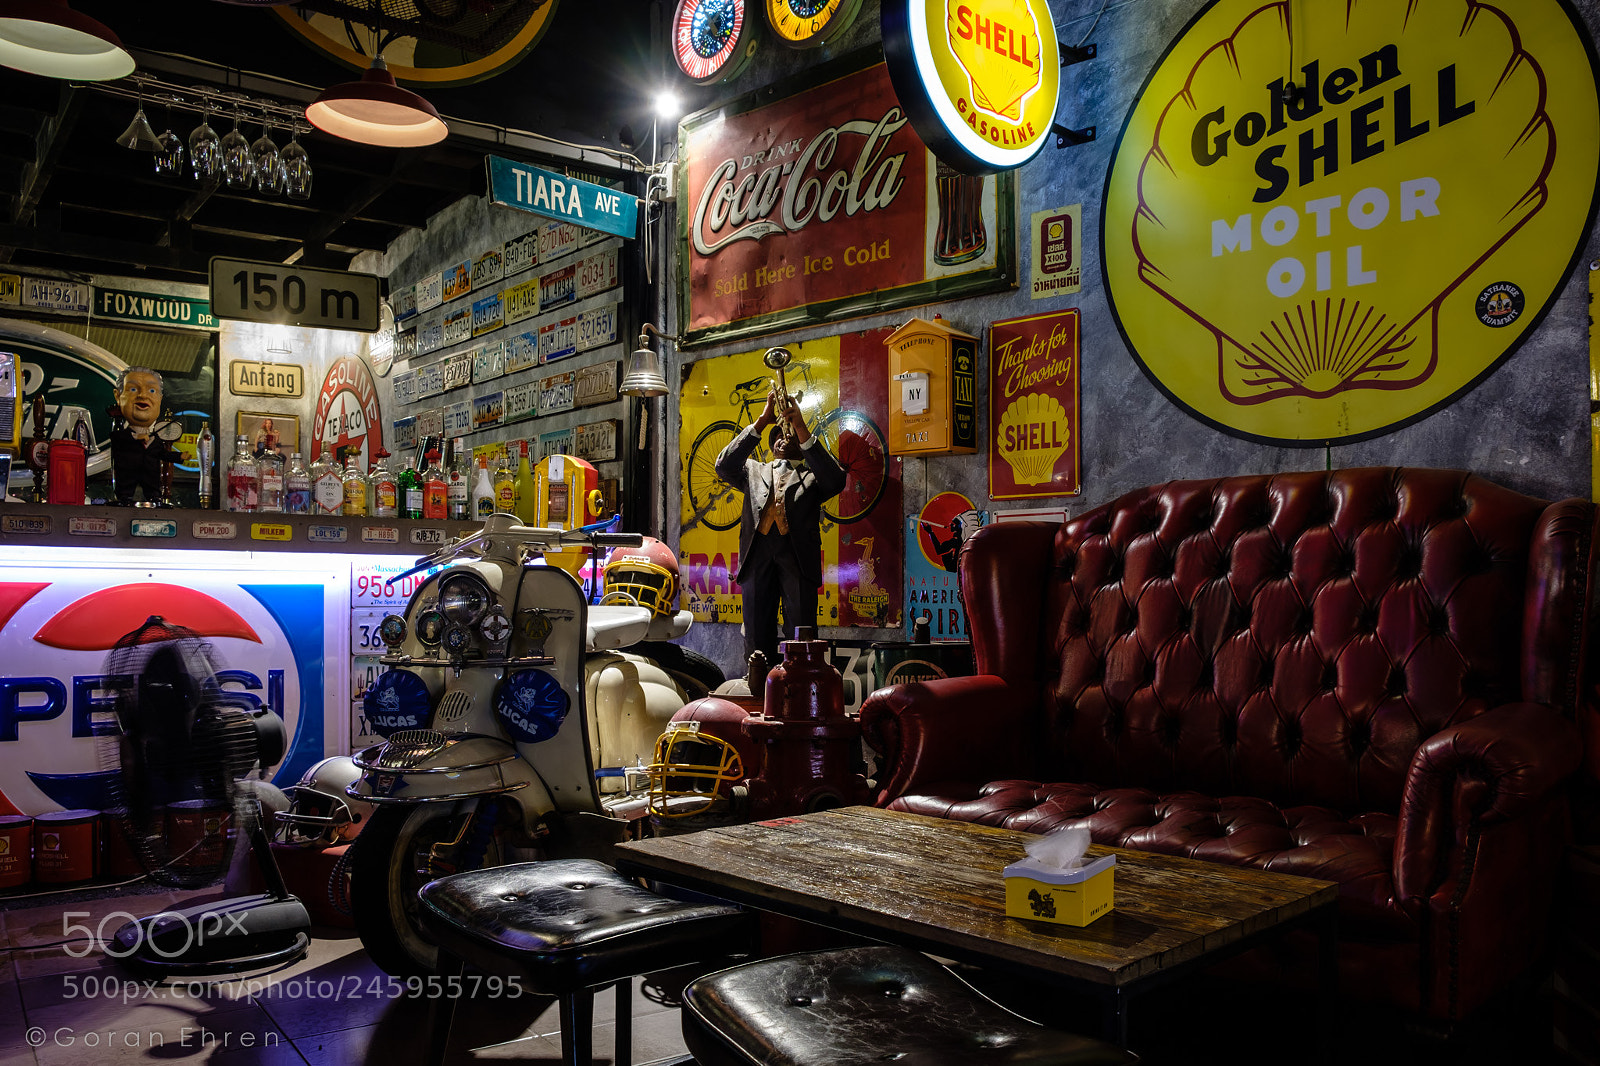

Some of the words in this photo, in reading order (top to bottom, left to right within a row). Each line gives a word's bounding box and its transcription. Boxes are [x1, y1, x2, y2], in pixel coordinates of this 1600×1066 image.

[956, 4, 1034, 69] SHELL
[1190, 43, 1402, 167] Golden
[957, 97, 1035, 145] GASOLINE
[1251, 63, 1476, 203] SHELL
[740, 137, 804, 171] DRINK
[511, 167, 583, 218] TIARA
[594, 191, 621, 216] AVE
[1211, 176, 1441, 258] MOTOR
[715, 270, 748, 297] Sold
[755, 264, 796, 288] Here
[803, 254, 834, 276] Ice
[843, 239, 891, 267] Cold
[1047, 253, 1064, 263] X100
[1266, 244, 1377, 299] OIL
[31, 284, 80, 305] AH-961
[233, 270, 306, 315] 150
[320, 288, 360, 321] m
[1480, 284, 1520, 302] SATHANEE
[103, 291, 191, 321] FOXWOOD
[198, 313, 213, 326] DR
[1481, 309, 1519, 326] RUAMMIT
[899, 337, 936, 352] TELEPHONE
[995, 333, 1048, 377] Thanks
[1045, 323, 1068, 360] for
[239, 365, 295, 394] Anfang
[955, 375, 973, 403] TAXI
[1004, 356, 1072, 398] Choosing
[314, 362, 378, 441] GASOLINE
[909, 388, 922, 401] NY
[328, 409, 362, 438] TEXACO
[905, 431, 929, 444] TAXI
[1004, 420, 1063, 453] SHELL
[358, 575, 395, 598] 956
[402, 575, 426, 598] DM
[909, 576, 960, 587] NATU
[688, 603, 700, 613] THE
[850, 595, 861, 603] THE
[862, 595, 888, 604] RALEIGH
[909, 589, 963, 604] AMERIC
[909, 606, 969, 635] SPIR
[359, 625, 387, 648] 36
[0, 668, 285, 743] PESI
[497, 699, 538, 735] LUCAS
[372, 714, 418, 728] LUCAS
